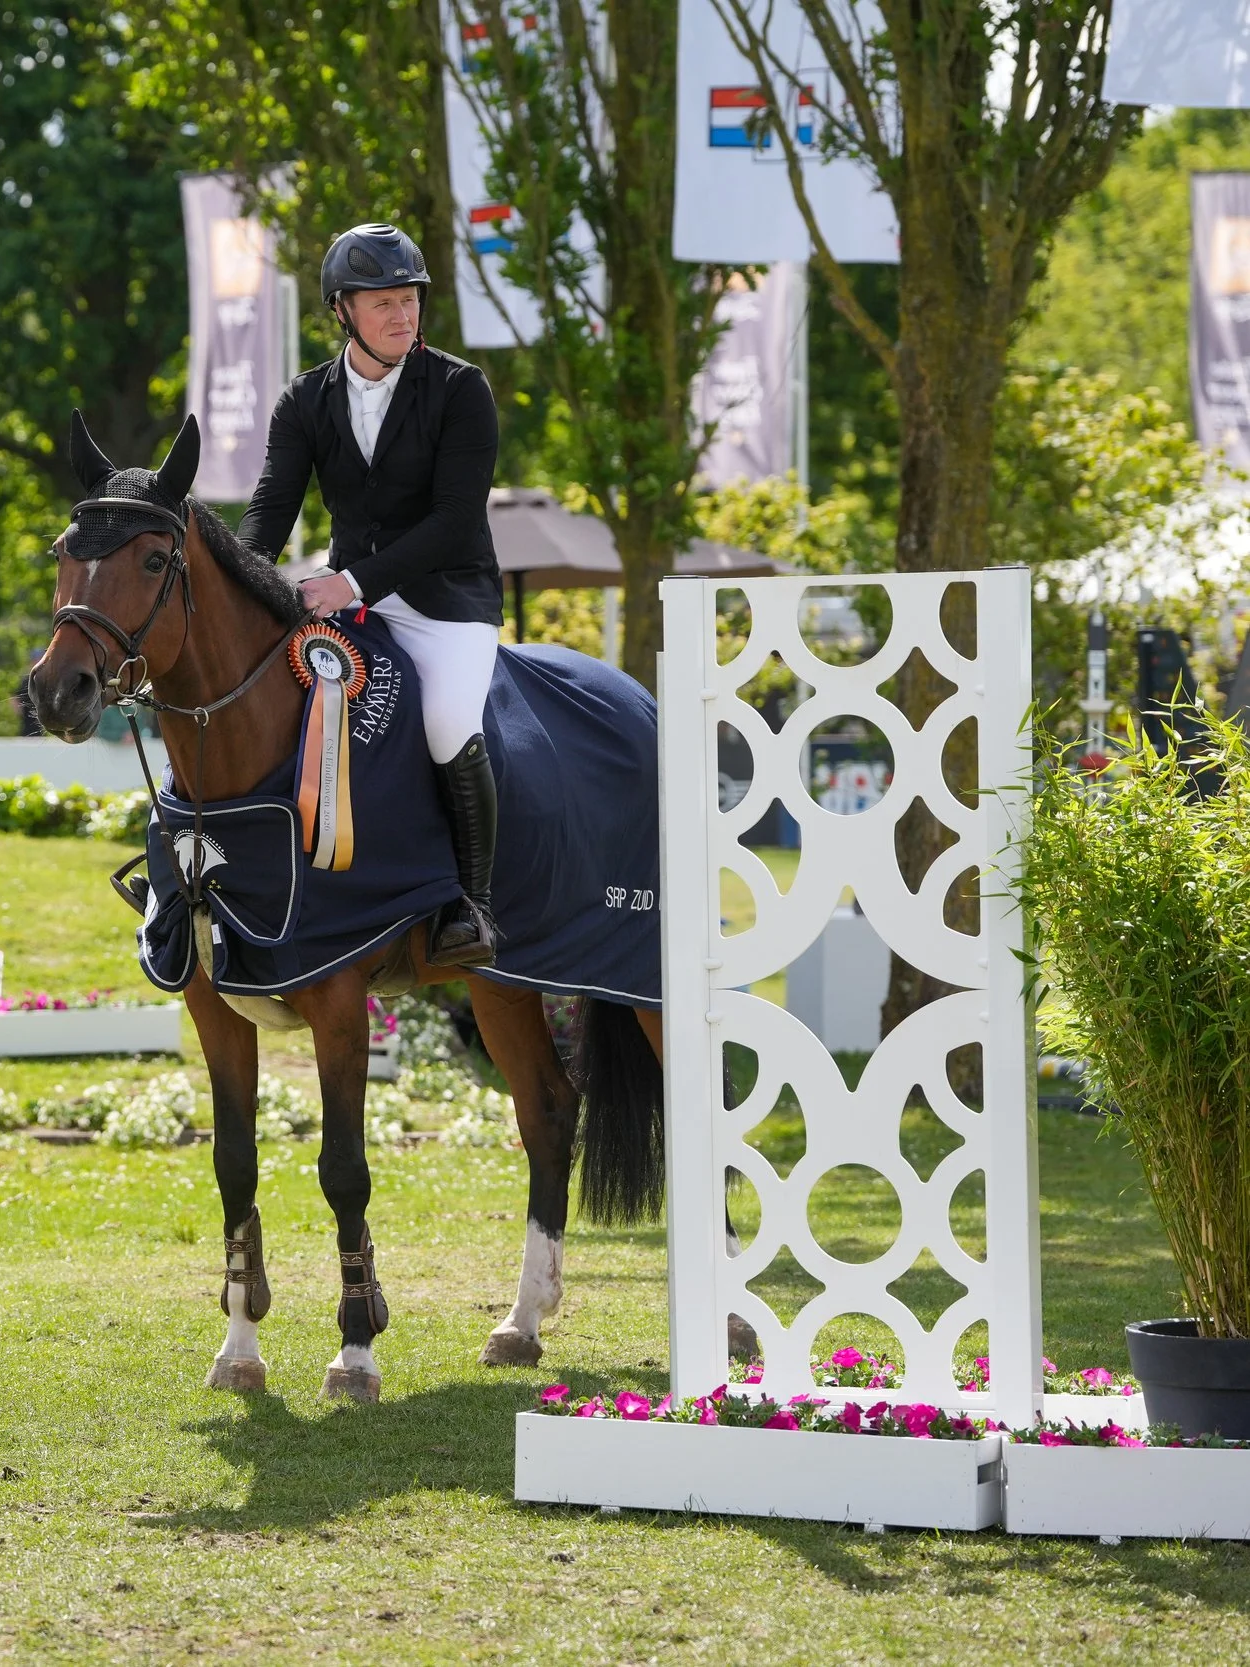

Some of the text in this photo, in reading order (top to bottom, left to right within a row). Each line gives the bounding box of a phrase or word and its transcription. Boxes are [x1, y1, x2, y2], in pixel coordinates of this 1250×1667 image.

[318, 664, 335, 675] CSI
[351, 654, 393, 745] EMMERS
[377, 670, 402, 735] EQUESTRIAN
[325, 738, 334, 755] CSI
[324, 757, 334, 807] Eindhoven
[605, 886, 627, 908] SRP
